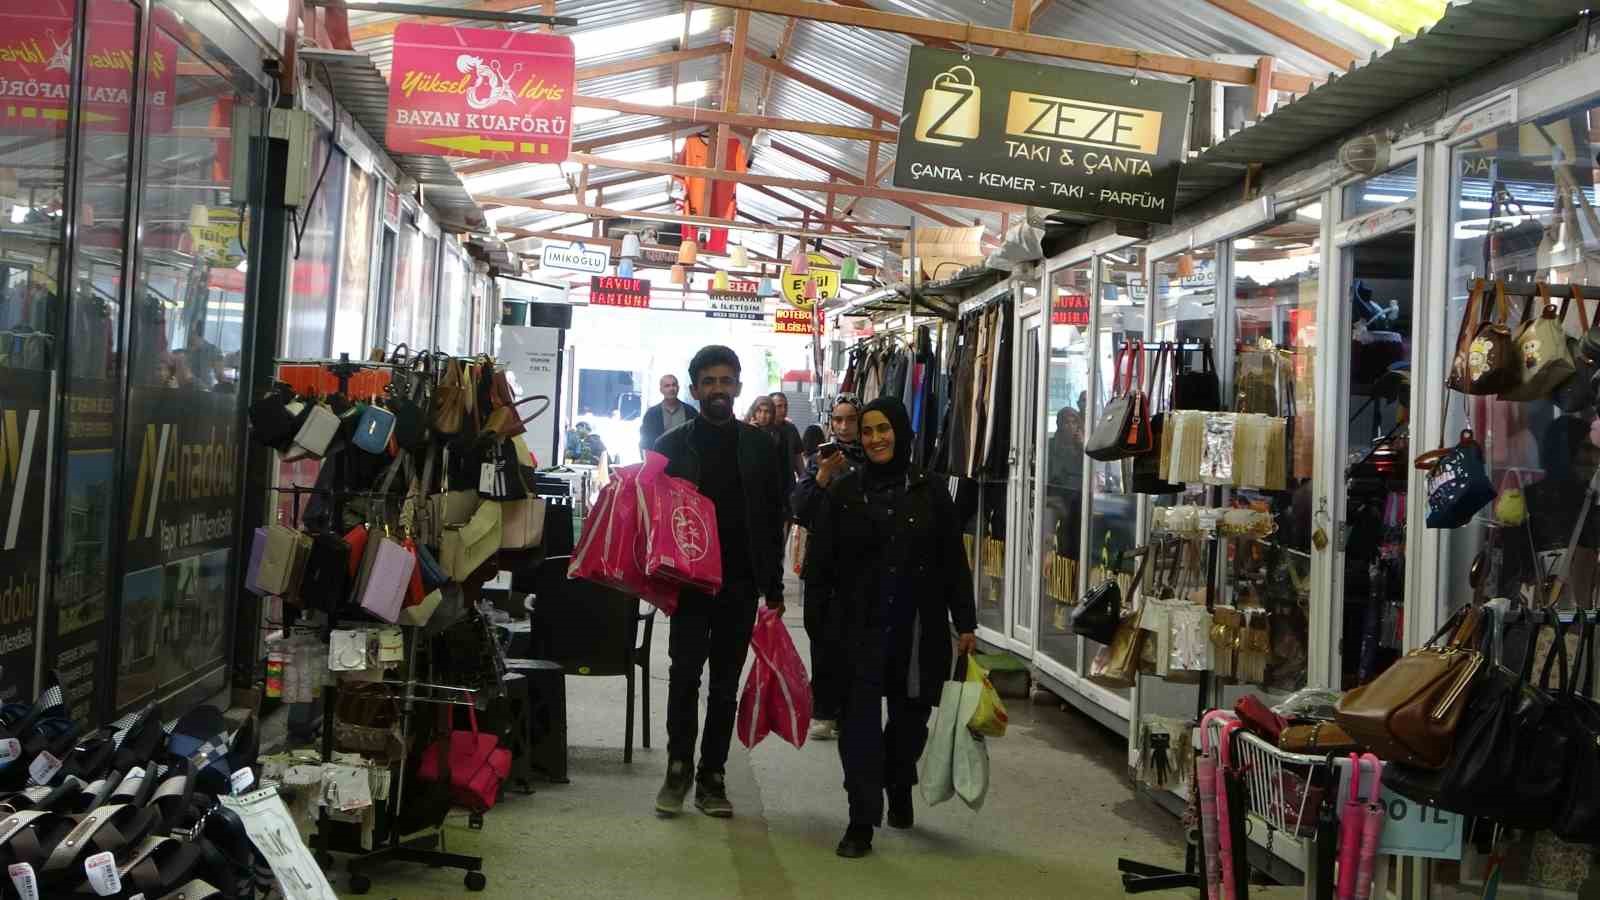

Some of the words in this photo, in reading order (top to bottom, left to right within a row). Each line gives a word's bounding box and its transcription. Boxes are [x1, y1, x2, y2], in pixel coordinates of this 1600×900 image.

[401, 70, 471, 98] Yüksel
[518, 73, 565, 101] İdris
[396, 109, 460, 128] BAYAN
[466, 112, 566, 135] KUAFÖRÜ
[1024, 97, 1145, 149] ZEZE
[1004, 141, 1050, 162] TAKI
[1058, 149, 1075, 167] &
[1083, 152, 1153, 177] ÇANTA
[911, 163, 963, 182] ÇANTA
[979, 172, 1036, 192] KEMER
[1050, 182, 1085, 198] TAKI
[1100, 189, 1165, 210] PARFÜM
[728, 282, 758, 293] EHA
